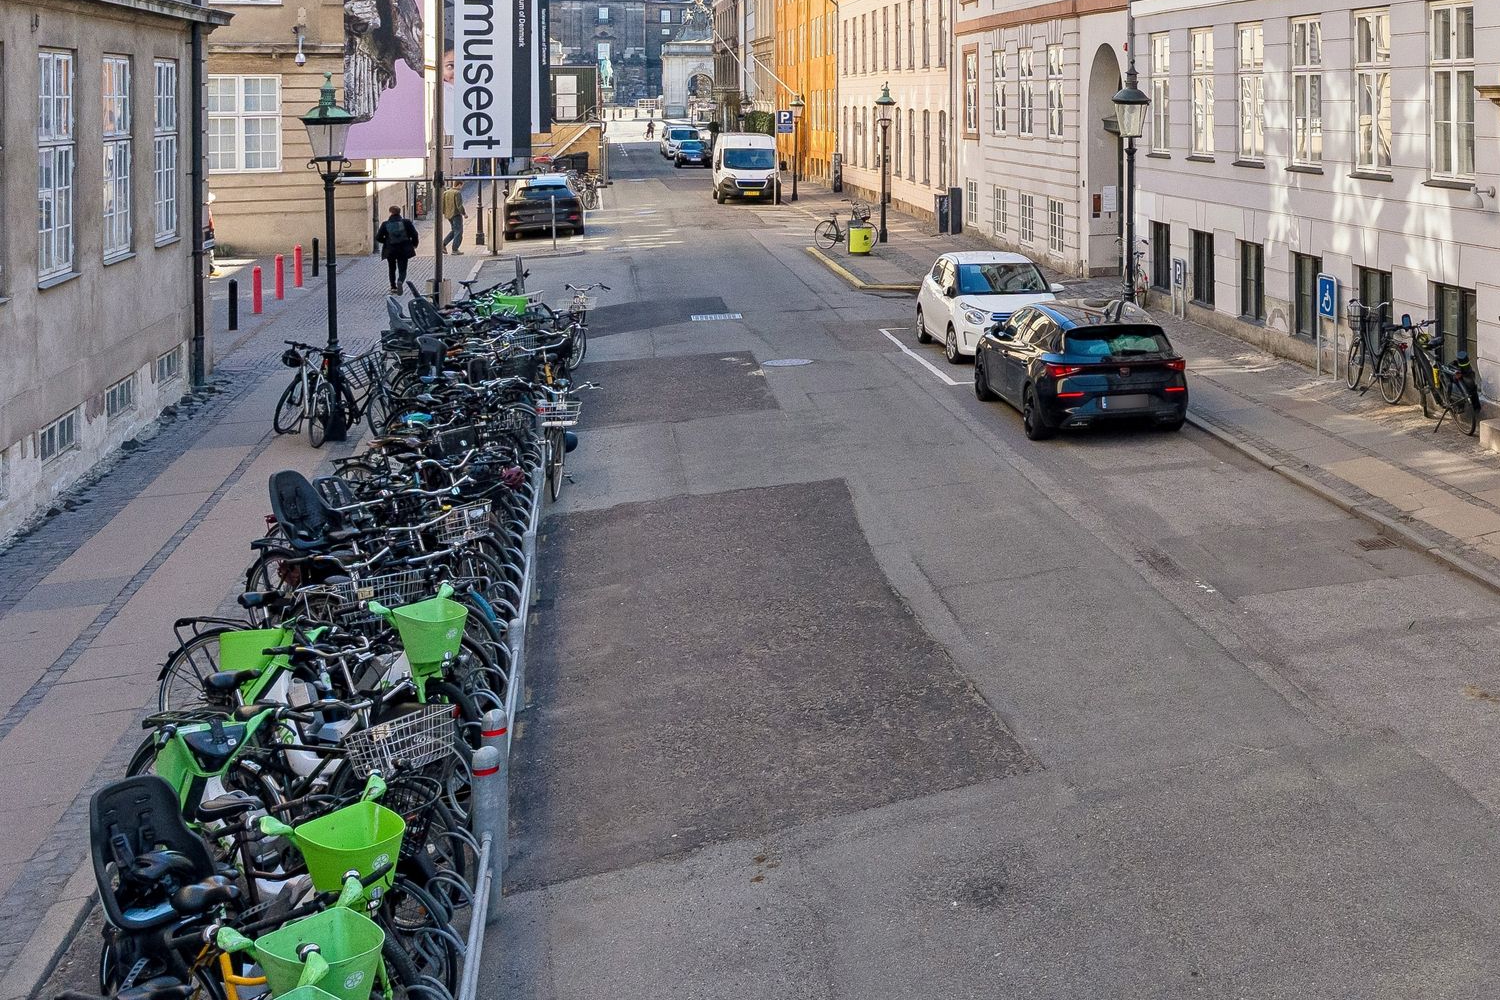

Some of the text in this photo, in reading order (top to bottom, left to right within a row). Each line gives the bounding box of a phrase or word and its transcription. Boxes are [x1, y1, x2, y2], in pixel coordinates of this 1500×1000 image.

[518, 10, 526, 18] of
[518, 18, 526, 48] Denmark
[780, 111, 790, 124] P
